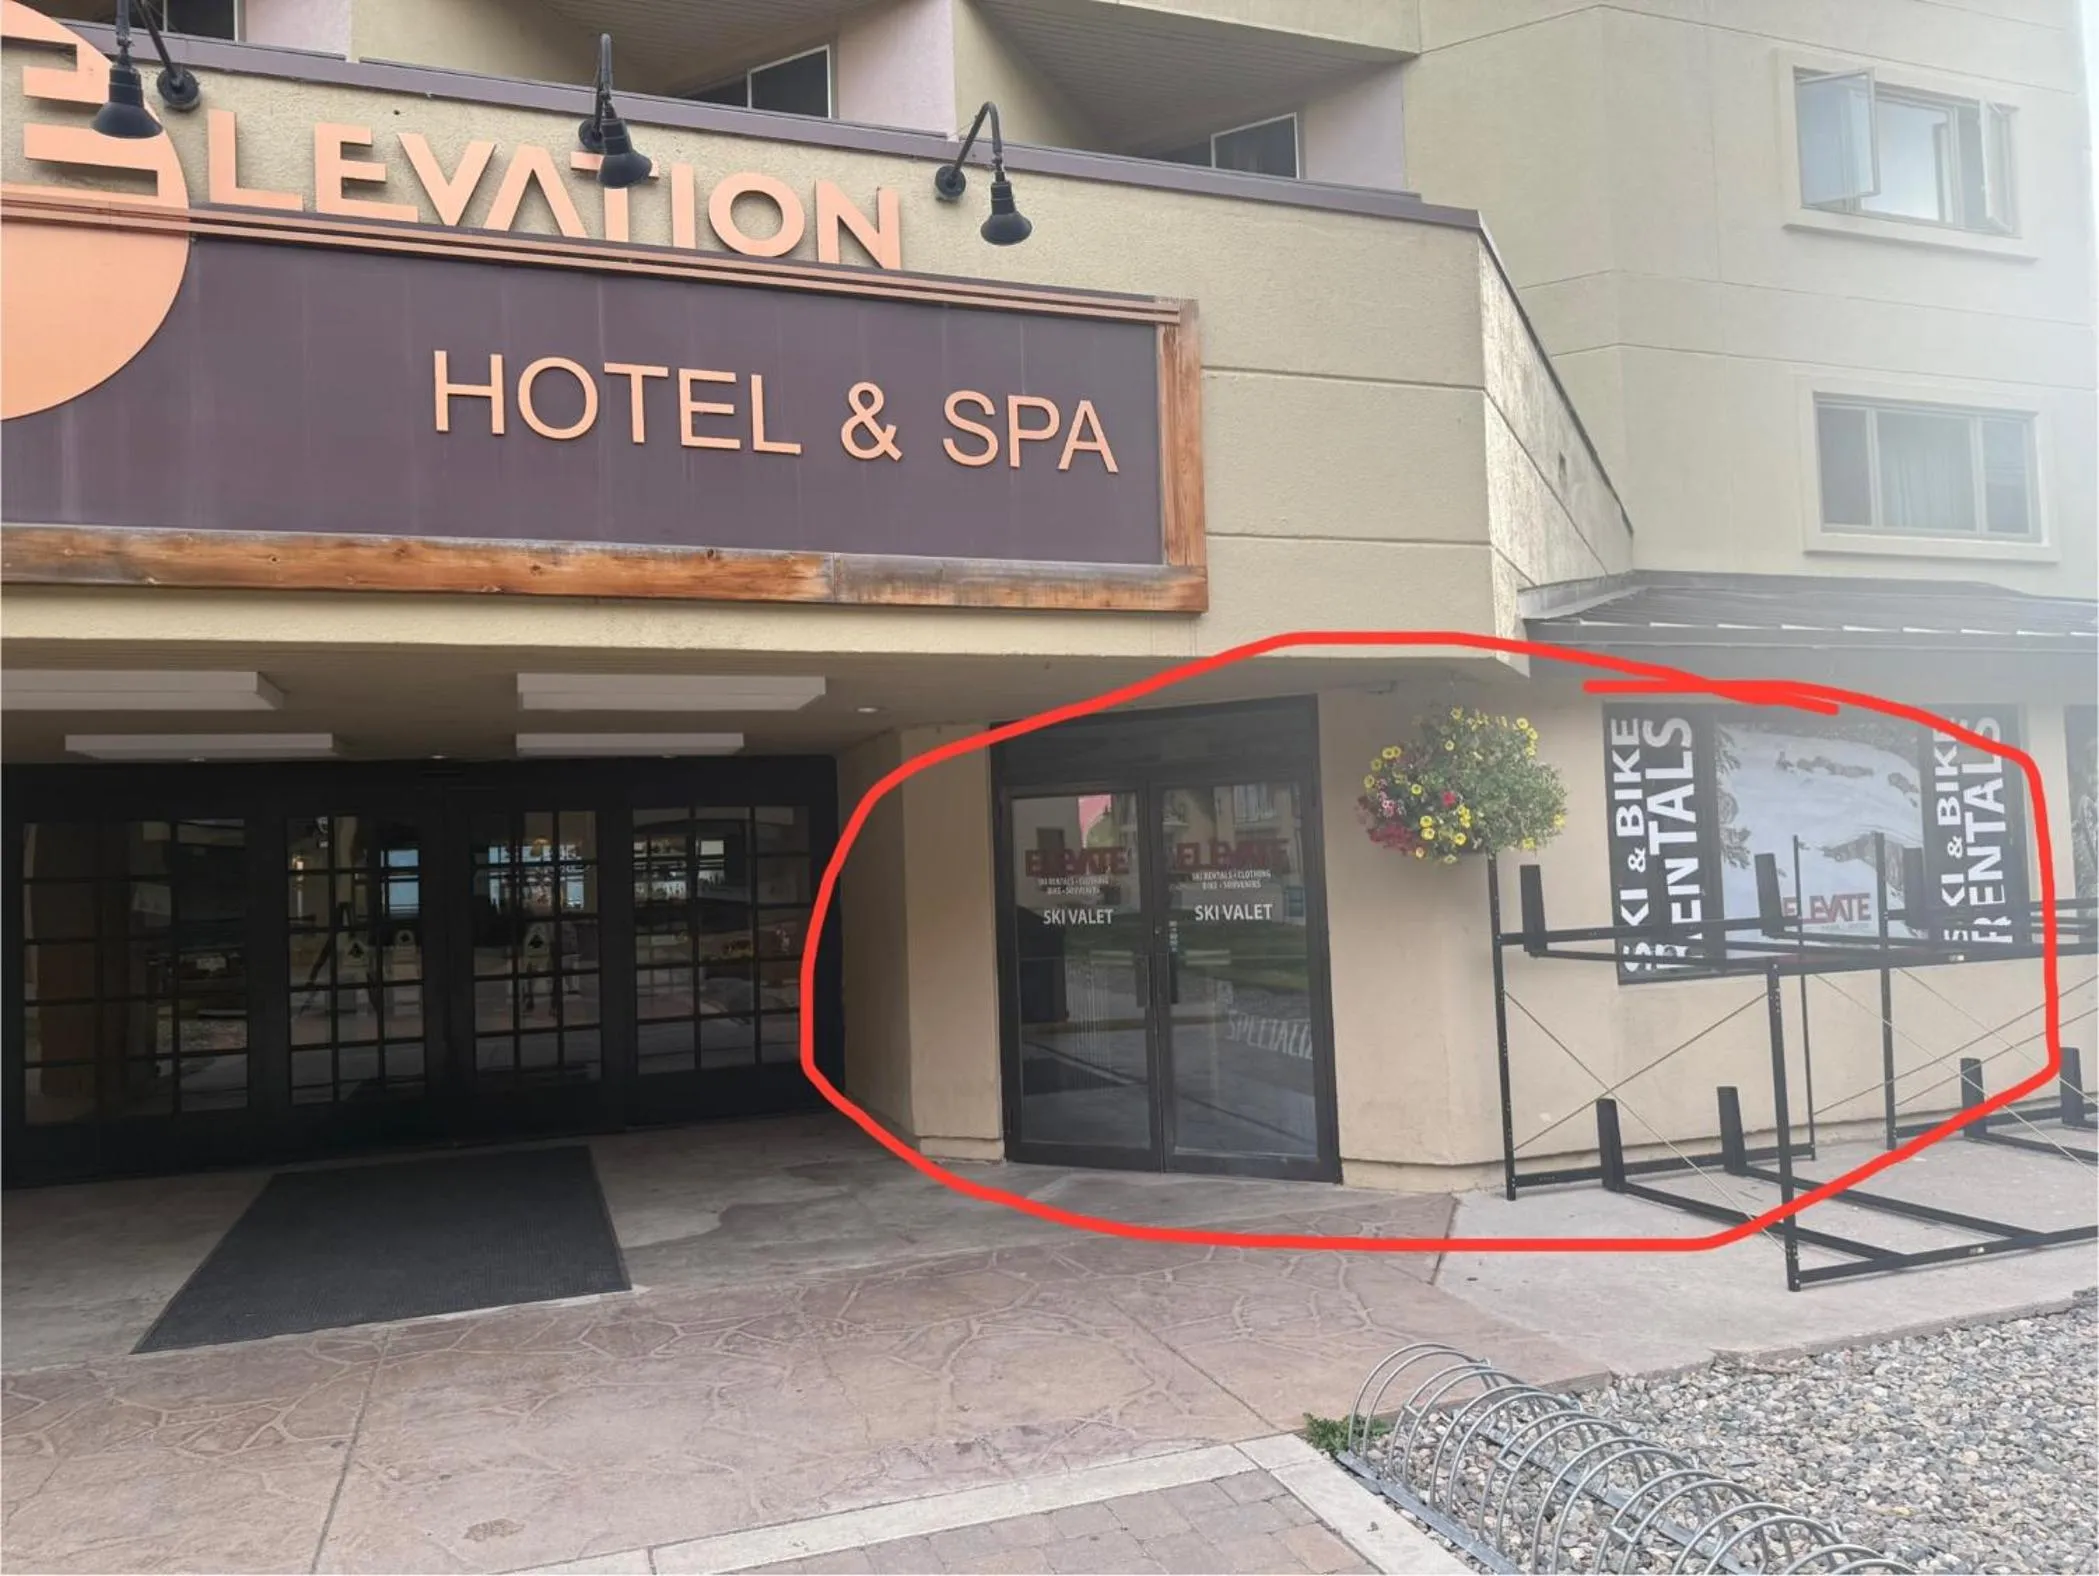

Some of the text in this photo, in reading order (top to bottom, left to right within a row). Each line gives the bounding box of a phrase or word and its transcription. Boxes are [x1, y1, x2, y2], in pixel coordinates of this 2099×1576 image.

[2, 36, 903, 271] ELEVATION
[434, 350, 1119, 473] HOTEL & SPA
[1611, 718, 1645, 837] BIKE
[1627, 847, 1646, 873] &
[1947, 836, 1964, 859] &
[1043, 908, 1114, 925] SKI VALET
[1194, 903, 1273, 921] SKI VALET
